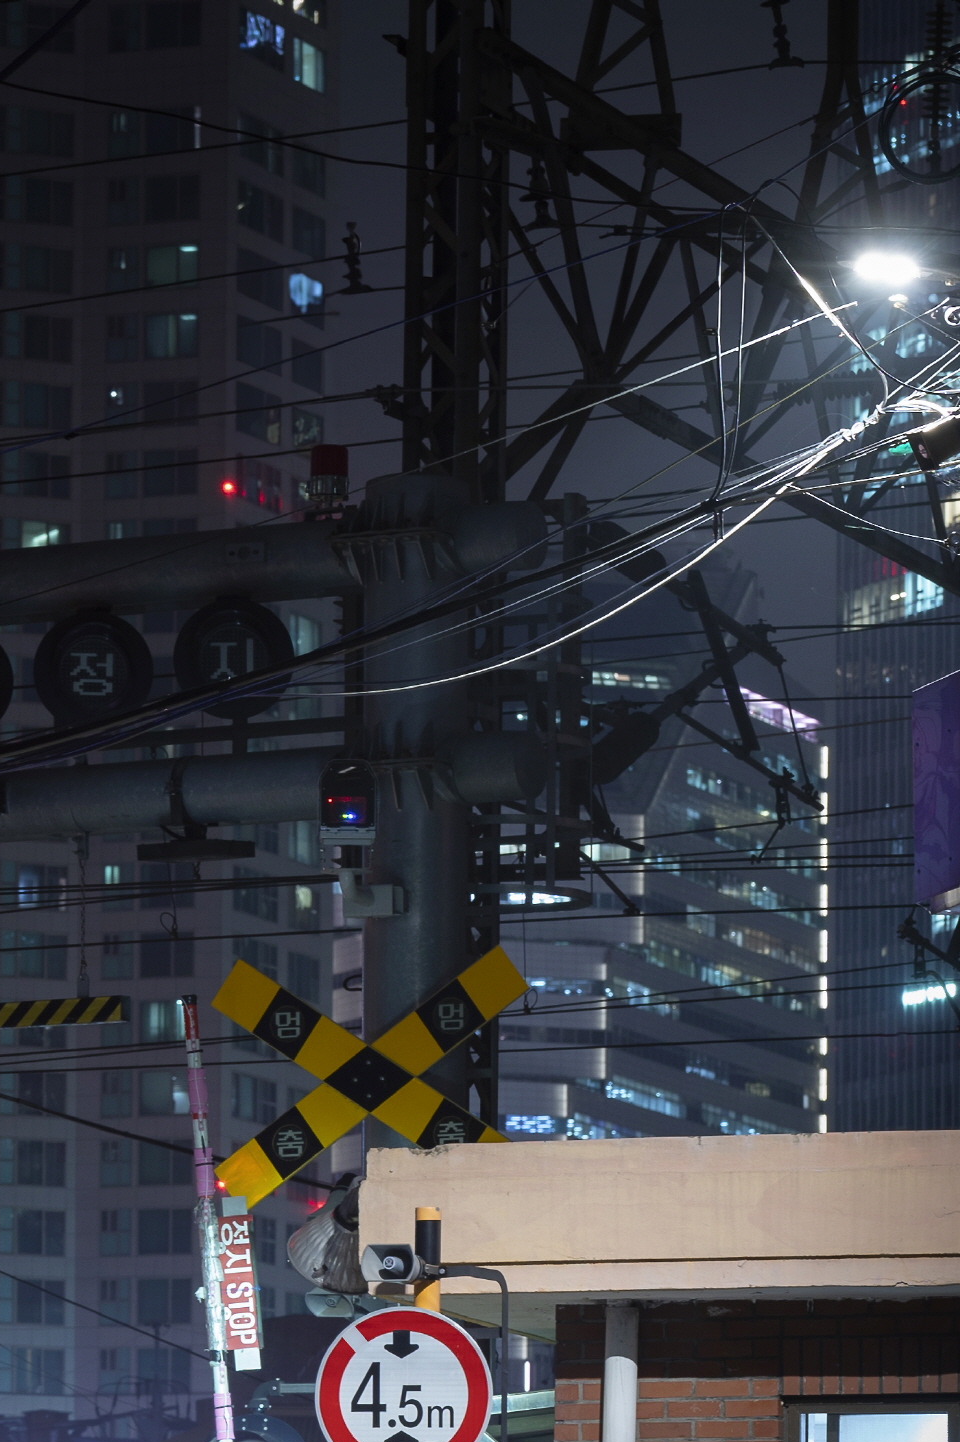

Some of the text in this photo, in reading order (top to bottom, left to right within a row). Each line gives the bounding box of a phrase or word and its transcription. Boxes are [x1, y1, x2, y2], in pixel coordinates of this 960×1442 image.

[220, 1220, 257, 1345] 정지 STOP
[351, 1361, 455, 1428] 4.5m
